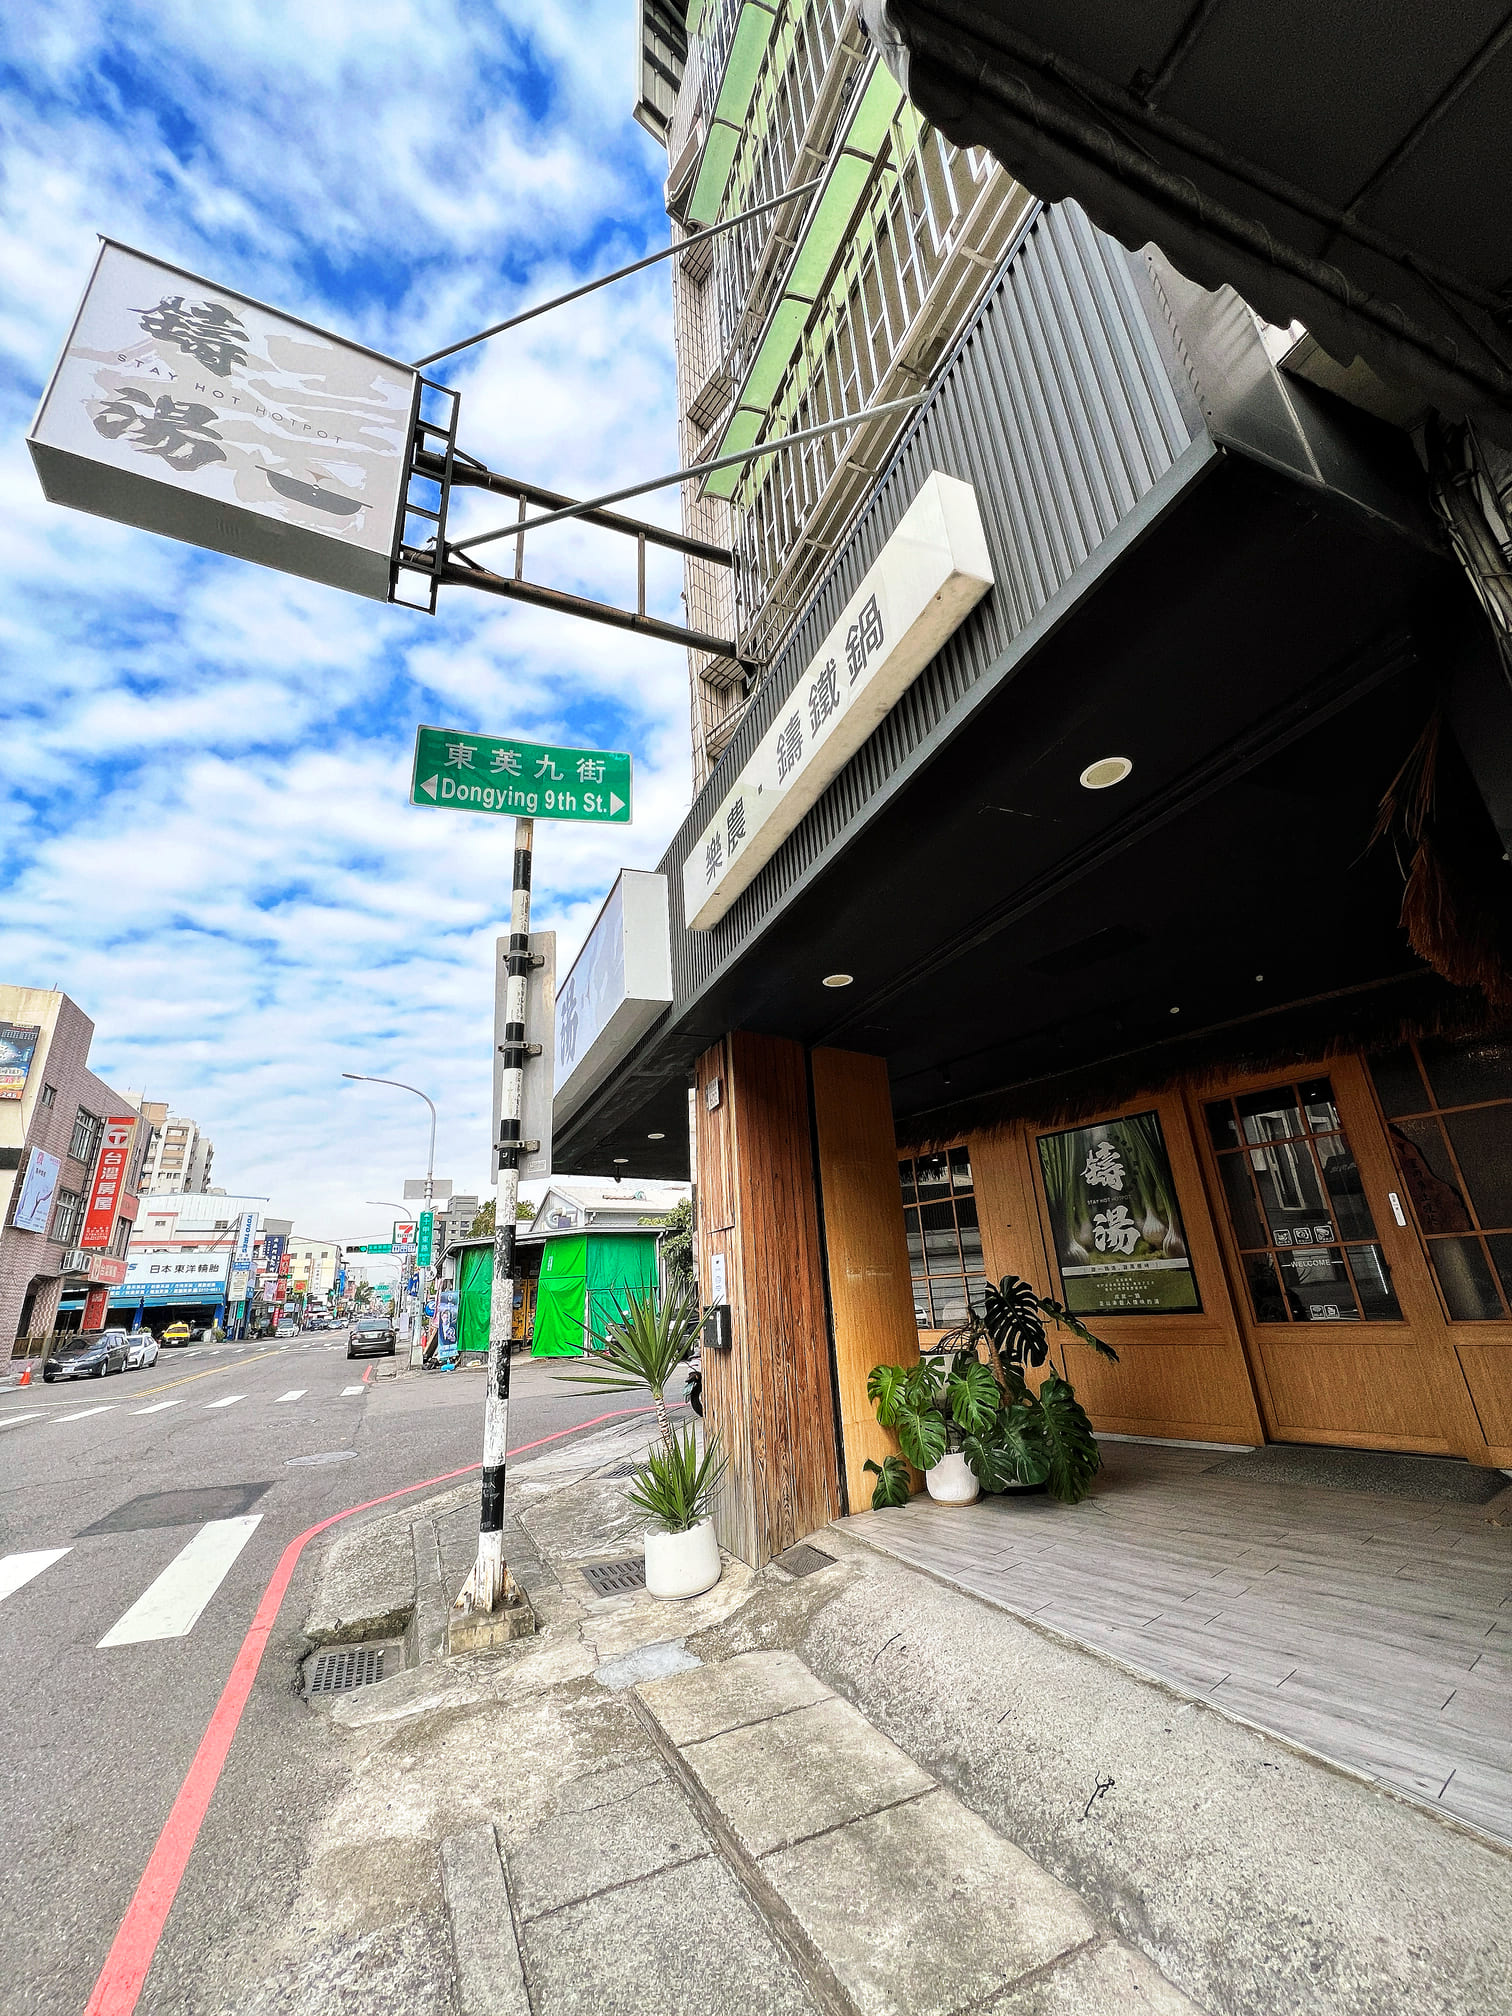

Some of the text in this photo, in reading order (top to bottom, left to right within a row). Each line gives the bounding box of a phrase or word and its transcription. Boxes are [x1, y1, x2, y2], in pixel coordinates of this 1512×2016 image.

[117, 352, 343, 444] STAY HOT HOTPOT
[443, 742, 606, 785] 東英九街
[441, 777, 607, 814] Dongying 9th St.
[93, 1151, 122, 1211] 台灣房屋
[1092, 1205, 1141, 1256] 湯
[1290, 1258, 1332, 1268] WELCOME
